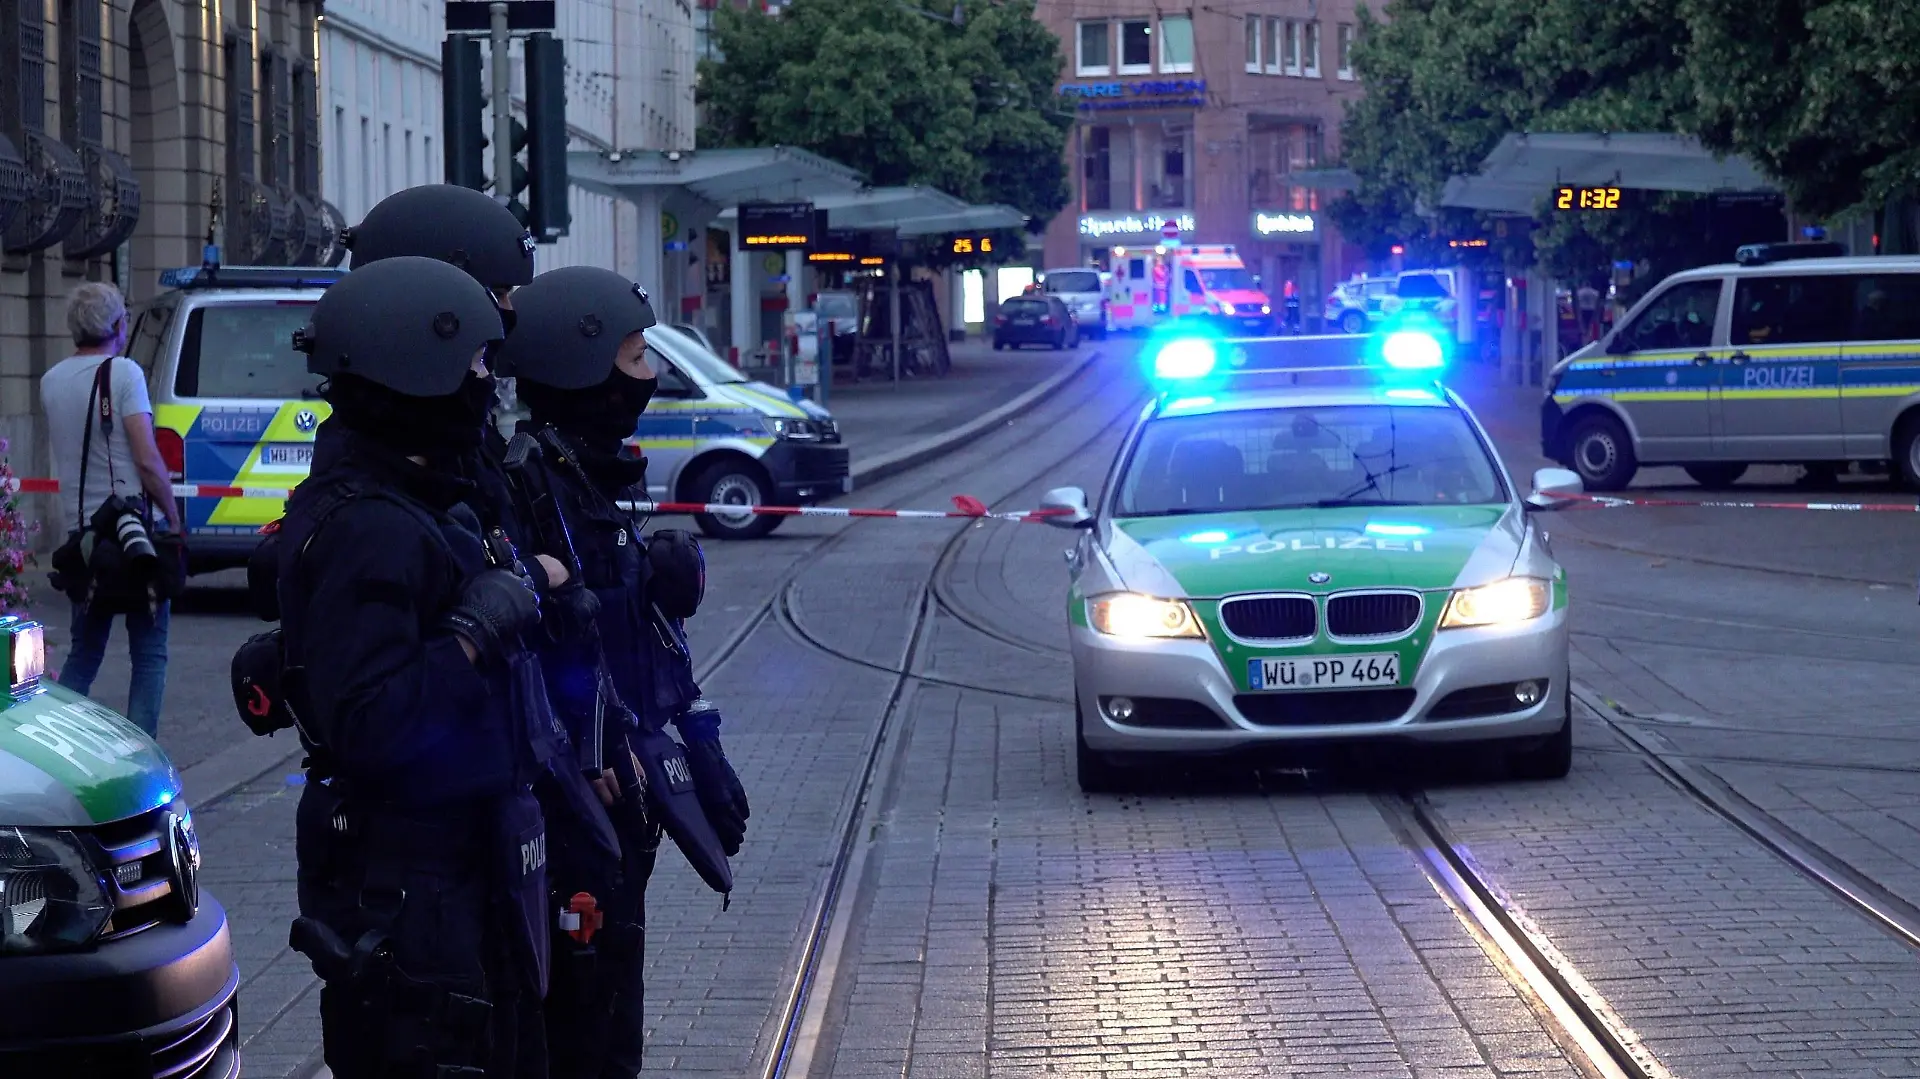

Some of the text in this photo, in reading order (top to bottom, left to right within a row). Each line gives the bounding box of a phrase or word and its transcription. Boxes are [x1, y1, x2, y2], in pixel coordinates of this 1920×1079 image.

[1128, 79, 1206, 95] VISION
[1558, 188, 1620, 208] 21:32
[1744, 366, 1815, 387] POLIZEI
[201, 418, 260, 433] POLIZEI
[1210, 537, 1424, 559] POLIZEI
[1264, 657, 1396, 686] WÜ PP 464
